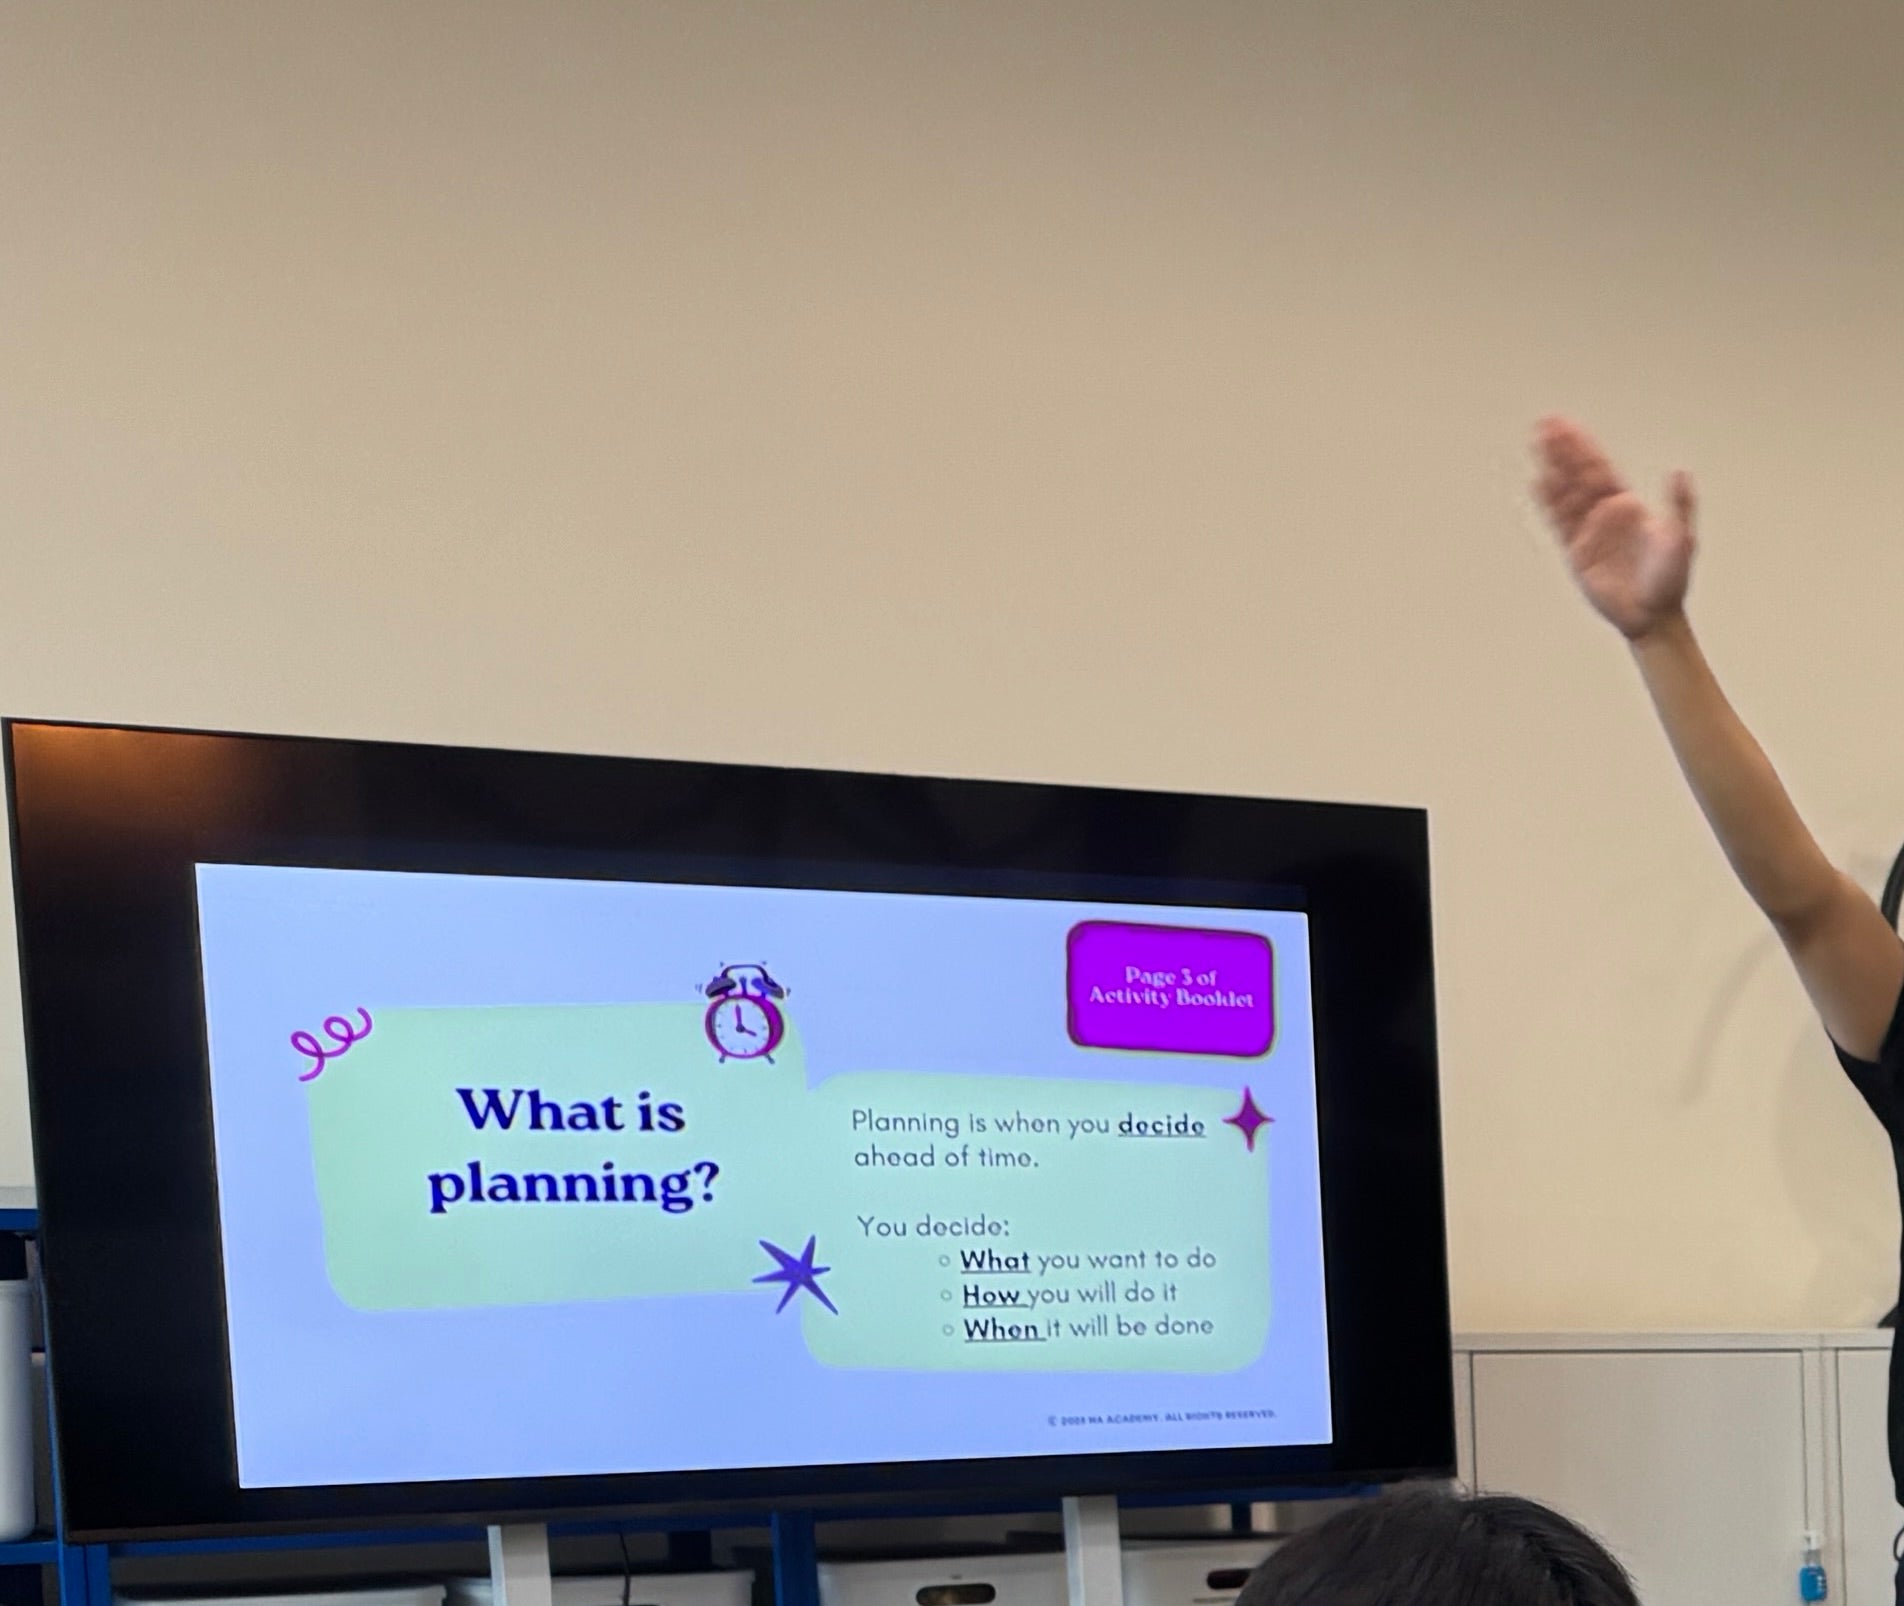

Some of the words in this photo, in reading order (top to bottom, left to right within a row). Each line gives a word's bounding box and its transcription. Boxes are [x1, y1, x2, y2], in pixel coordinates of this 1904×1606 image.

[1125, 965, 1176, 989] Page
[1181, 967, 1193, 986] 3
[1196, 969, 1217, 987] of
[1090, 985, 1170, 1009] Activity
[1176, 988, 1254, 1008] Booklet
[455, 1088, 625, 1131] What
[638, 1090, 686, 1132] is
[853, 1110, 959, 1138] Planning
[970, 1113, 986, 1133] is
[995, 1112, 1060, 1134] when
[1069, 1115, 1109, 1139] you
[1118, 1112, 1206, 1136] decide
[855, 1144, 935, 1167] ahead
[945, 1144, 970, 1167] of
[979, 1147, 1039, 1168] time.
[427, 1160, 720, 1214] planning?
[858, 1215, 906, 1237] You
[916, 1214, 1010, 1237] decide:
[961, 1249, 1031, 1272] What
[1038, 1252, 1079, 1276] you
[1088, 1250, 1145, 1269] want
[1155, 1250, 1178, 1269] to
[1188, 1247, 1216, 1269] do
[963, 1285, 1020, 1307] How
[1028, 1287, 1069, 1310] you
[1078, 1281, 1115, 1303] will
[1125, 1281, 1155, 1302] do
[1163, 1282, 1177, 1301] it
[964, 1318, 1039, 1341] When
[1047, 1317, 1061, 1338] it
[1069, 1315, 1107, 1338] will
[1117, 1314, 1147, 1336] be
[1156, 1314, 1215, 1336] done
